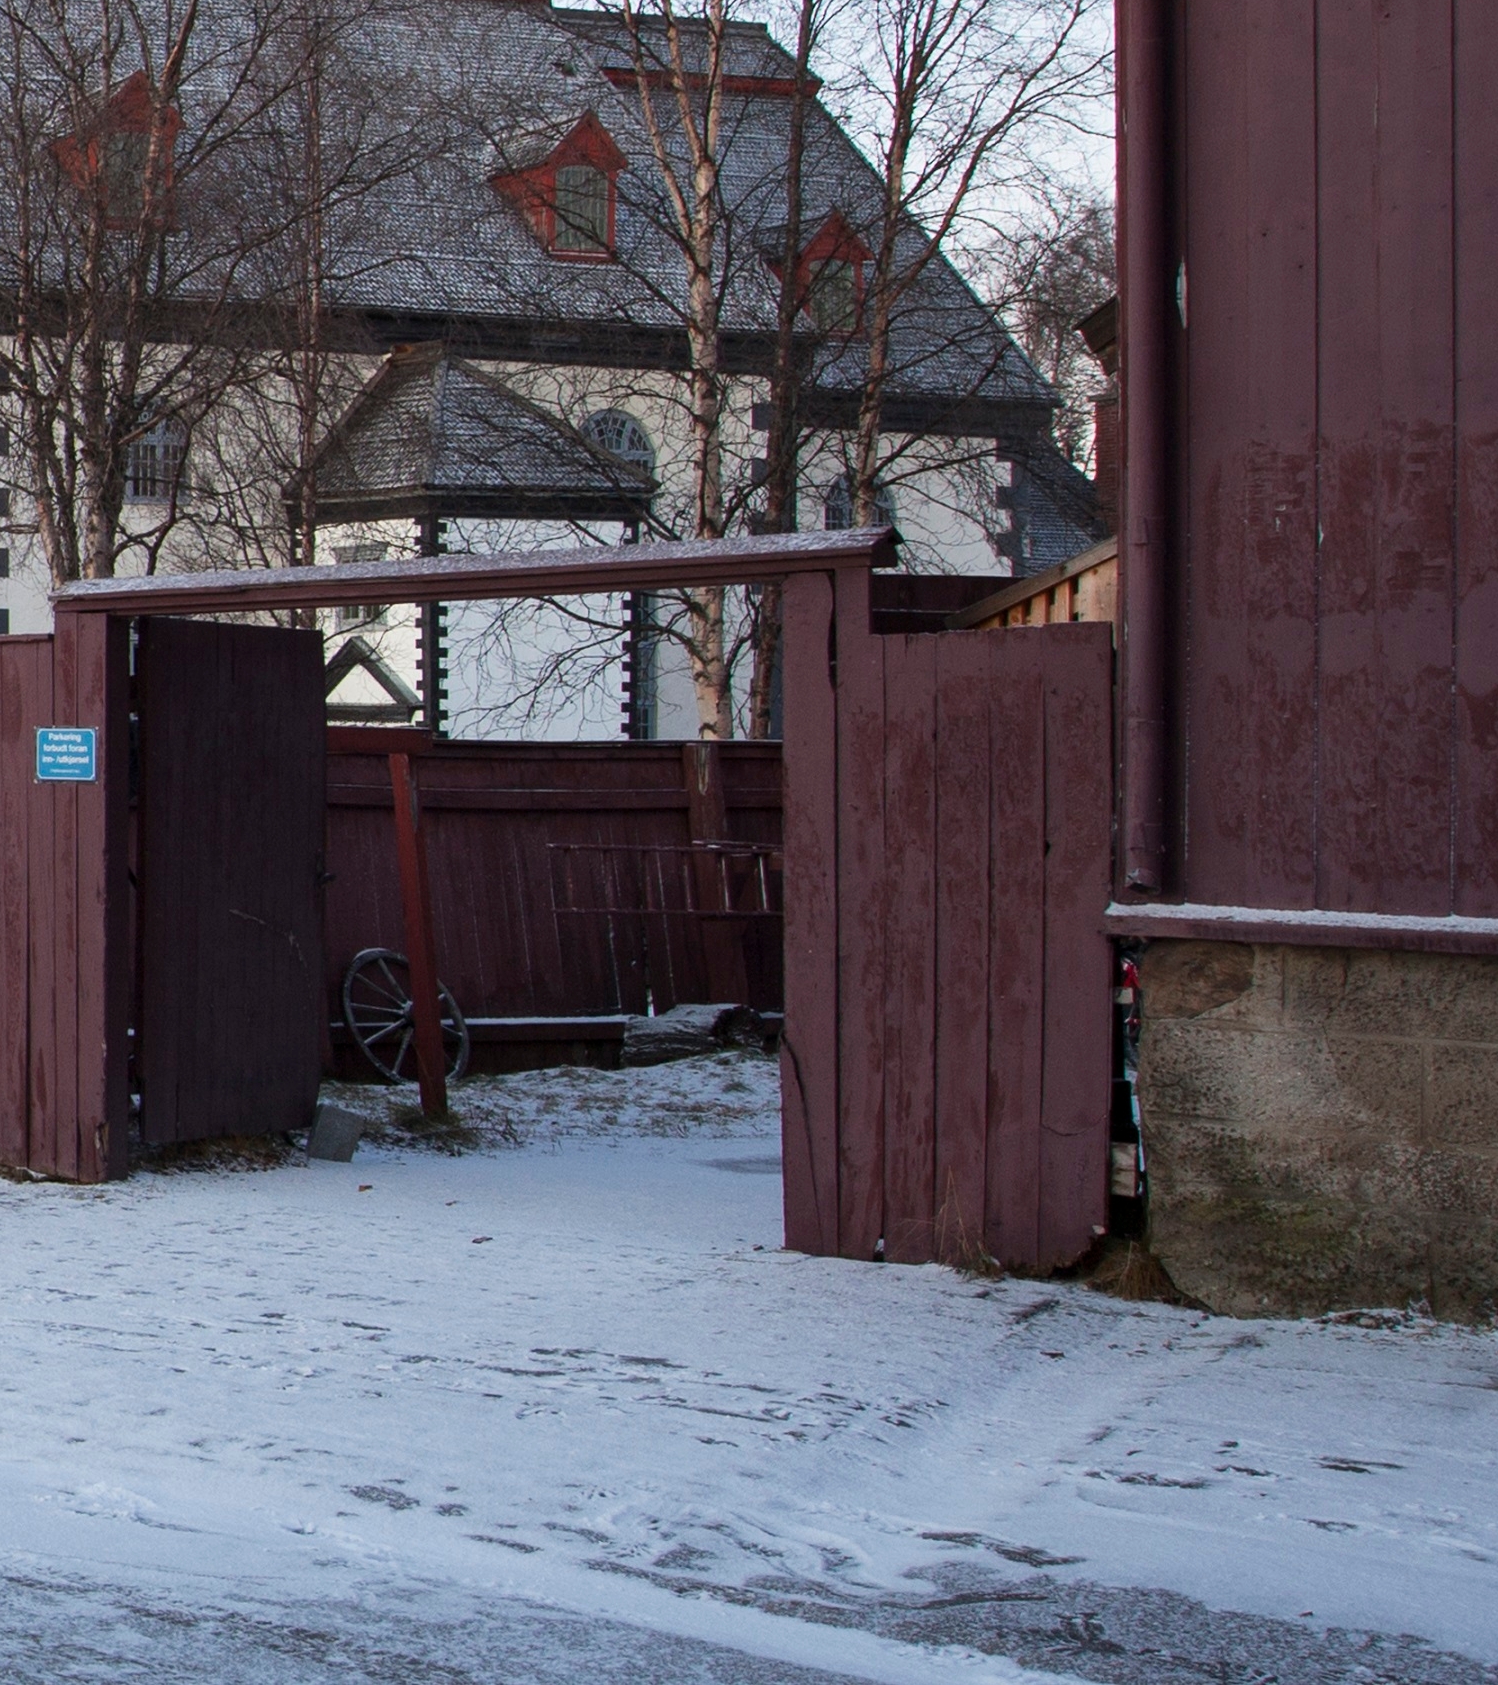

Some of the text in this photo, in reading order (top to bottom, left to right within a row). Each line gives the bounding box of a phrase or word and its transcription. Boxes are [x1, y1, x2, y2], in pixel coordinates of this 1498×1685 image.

[48, 732, 81, 742] Parkering
[43, 743, 88, 752] forbudt foran
